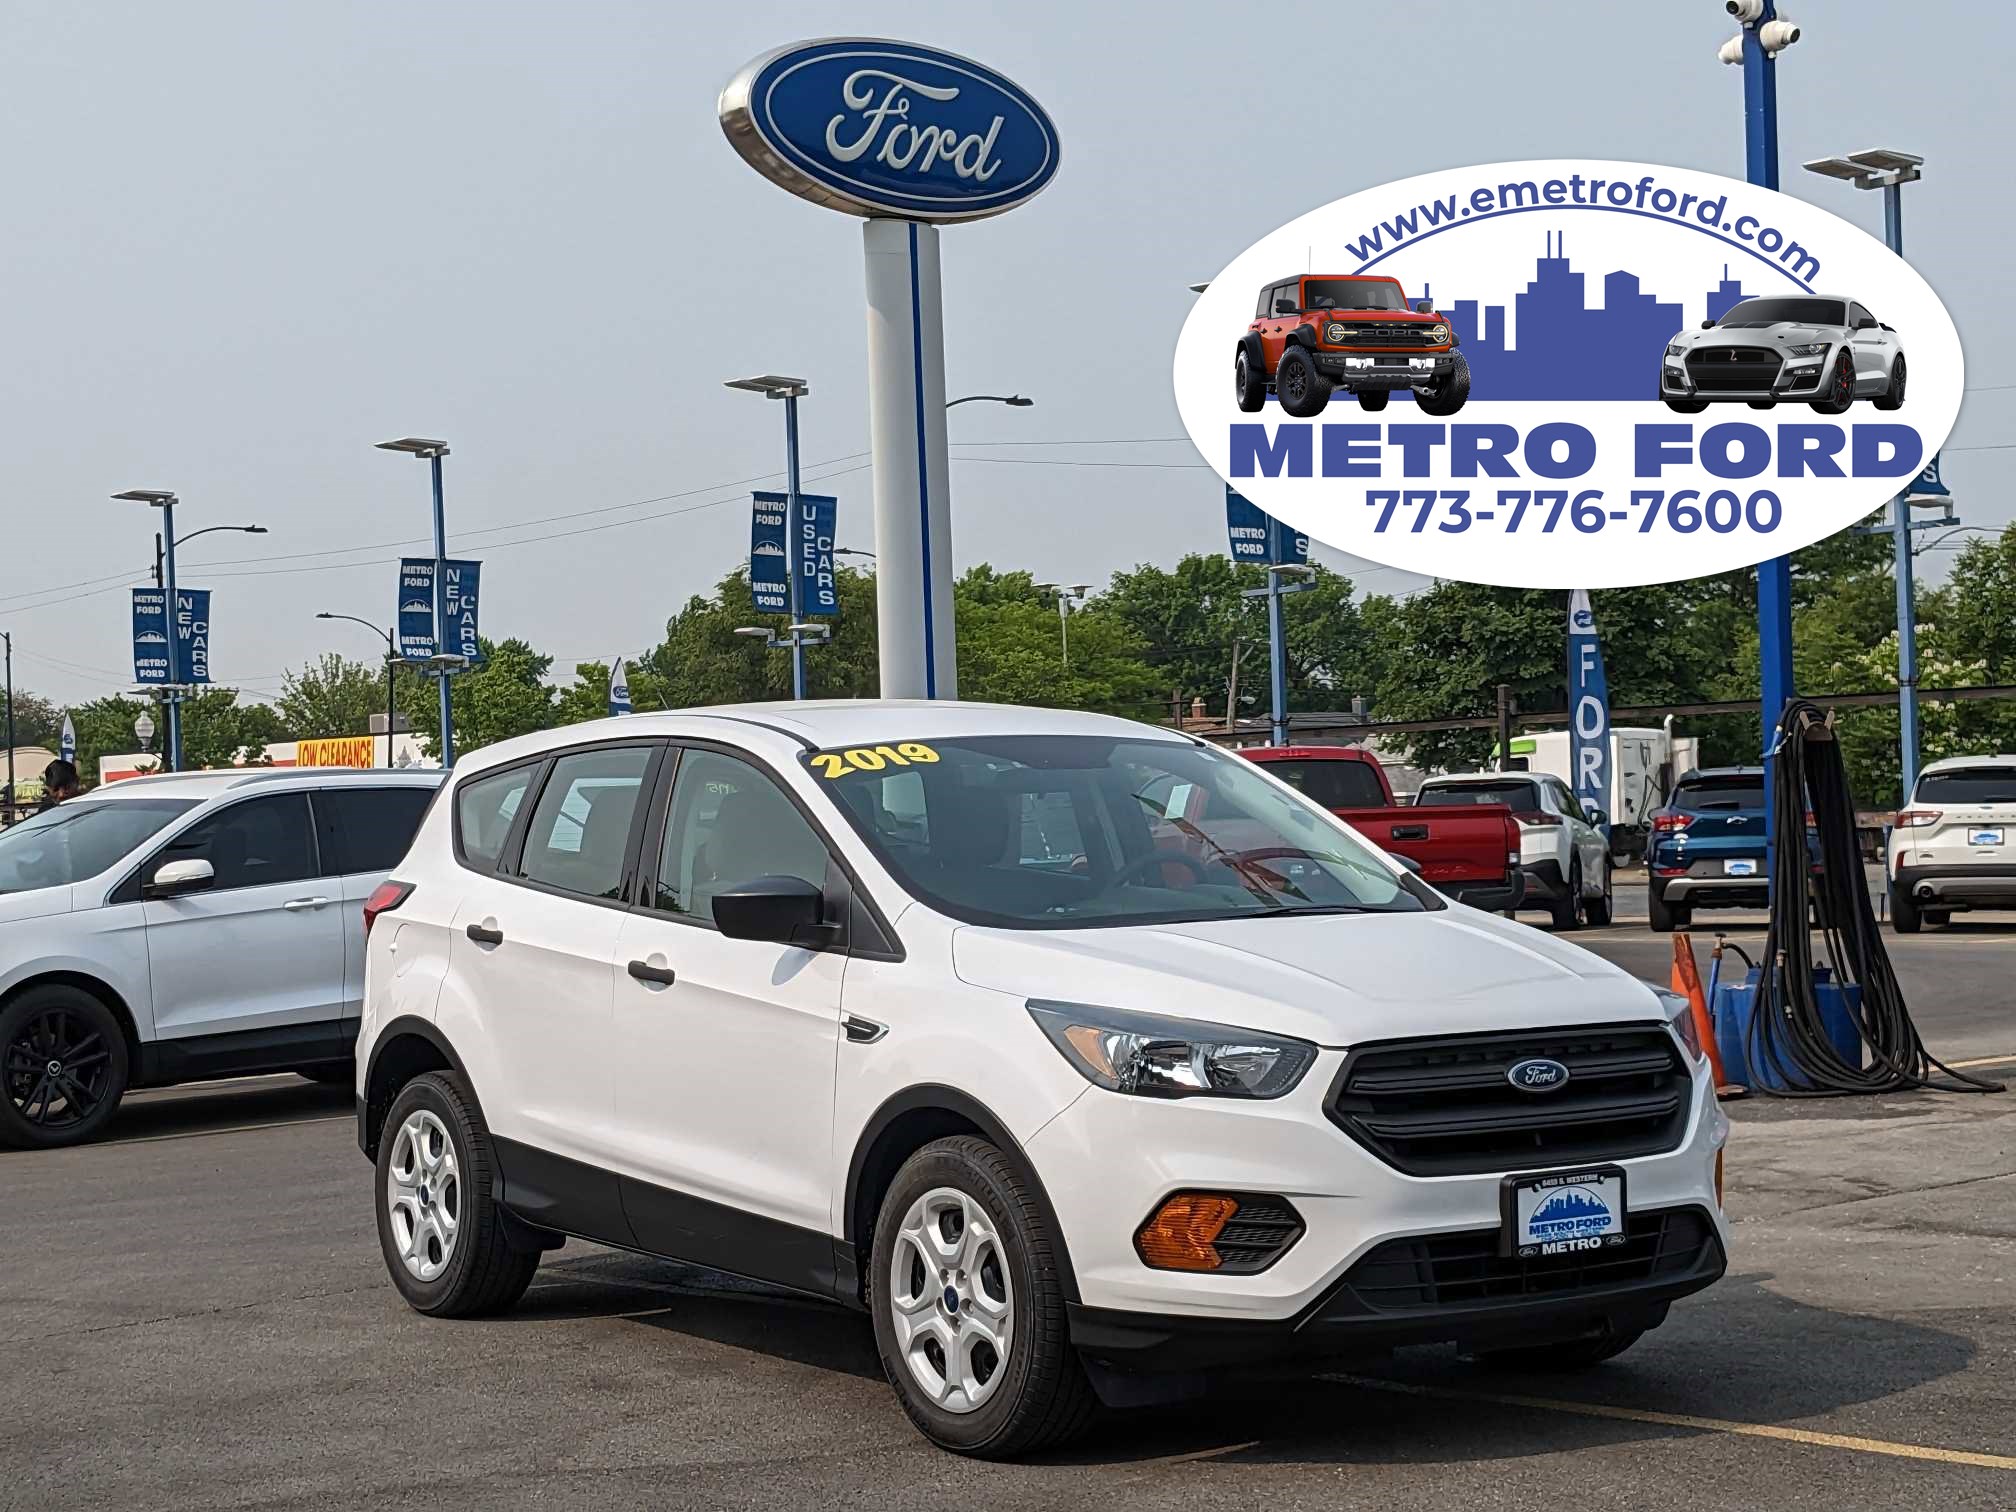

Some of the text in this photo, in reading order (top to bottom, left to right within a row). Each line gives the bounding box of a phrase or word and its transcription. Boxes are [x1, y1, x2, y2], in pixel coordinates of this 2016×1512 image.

[826, 69, 1004, 182] Ford
[754, 500, 786, 511] METRO
[755, 515, 782, 525] FORD
[1230, 528, 1265, 539] METRO
[803, 505, 816, 576] USED
[1235, 543, 1264, 554] FORD
[402, 566, 433, 574] METRO
[817, 537, 834, 605] CARS
[404, 578, 429, 587] FORD
[752, 582, 786, 593] METRO
[446, 569, 460, 615] NEW
[134, 595, 164, 603] METRO
[757, 596, 784, 606] FORD
[136, 606, 161, 614] FORD
[178, 597, 192, 640] NEW
[460, 596, 477, 656] CARS
[401, 636, 433, 645] METRO
[192, 621, 207, 677] CARS
[406, 647, 432, 656] FORD
[136, 659, 167, 667] METRO
[140, 669, 165, 678] FORD
[298, 738, 371, 768] LOW CLEARANCE
[811, 743, 940, 778] 2019
[1525, 1065, 1556, 1084] Ford
[1529, 1220, 1574, 1235] METRO
[1575, 1215, 1612, 1229] FORD
[1542, 1236, 1602, 1255] METRO
